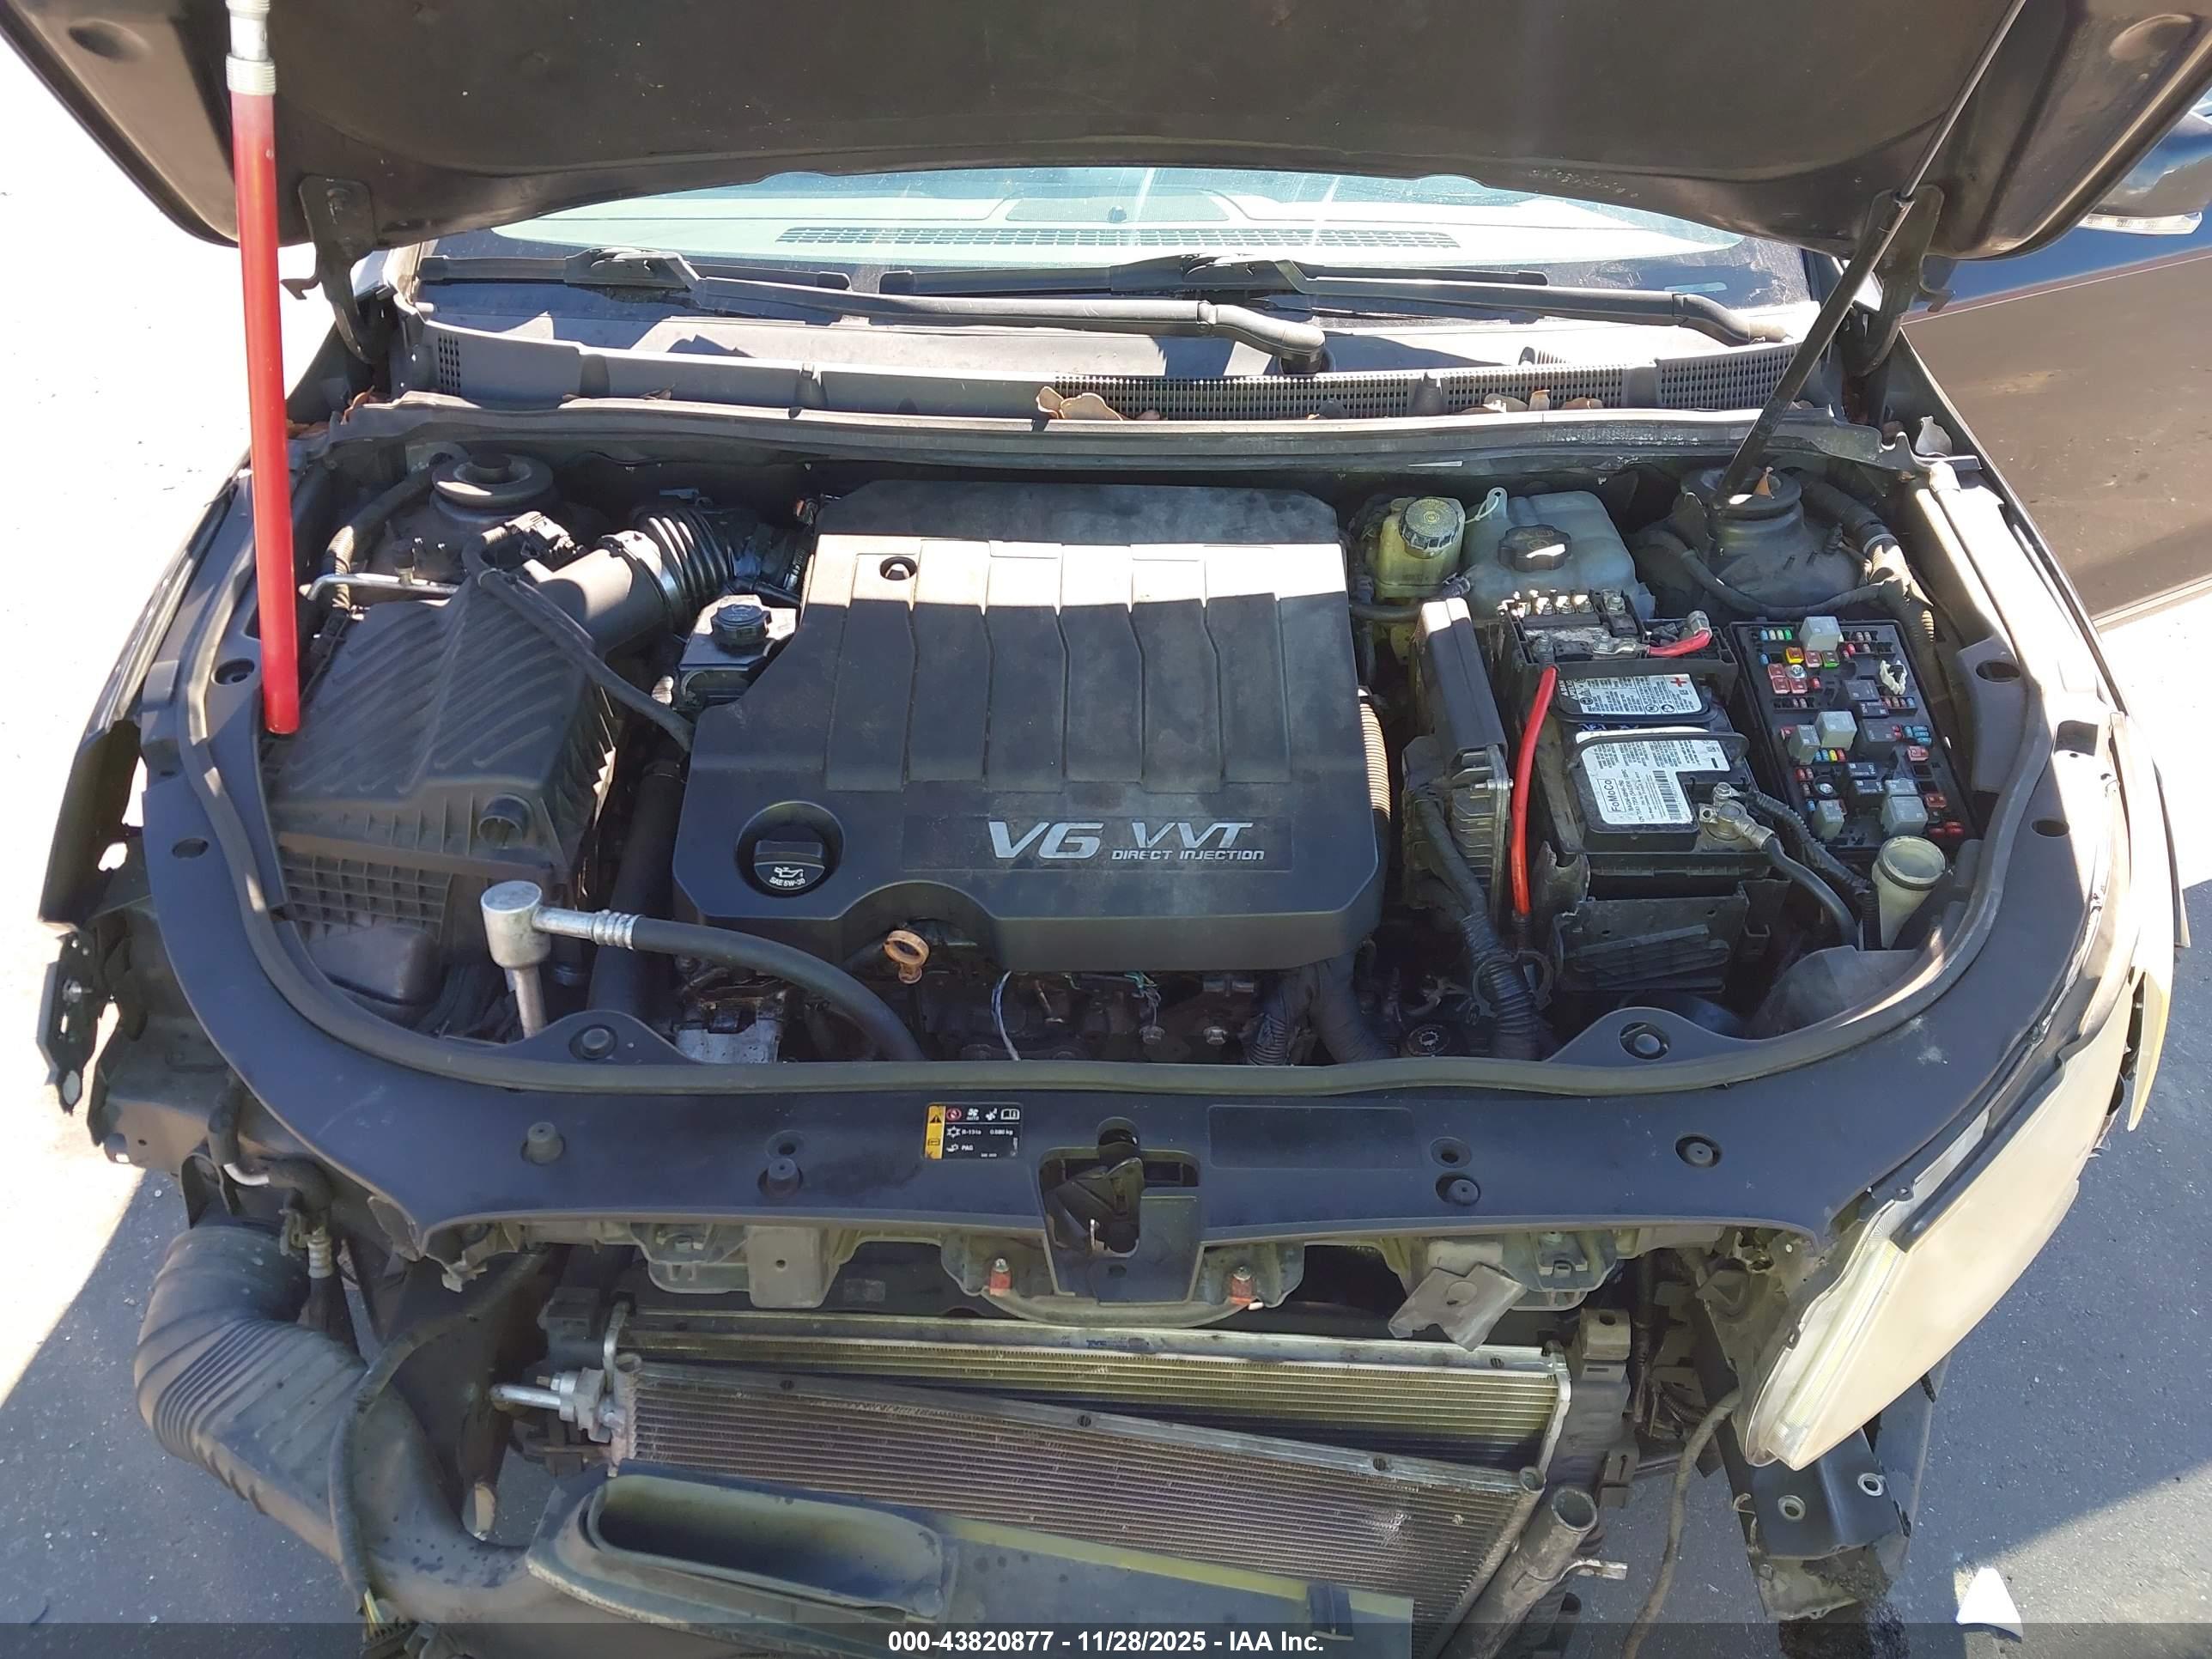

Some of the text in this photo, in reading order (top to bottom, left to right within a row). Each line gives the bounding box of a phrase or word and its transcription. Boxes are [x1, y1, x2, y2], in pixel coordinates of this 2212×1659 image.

[1604, 780, 1621, 812] FoMoCo
[988, 820, 1254, 860] V6 VVT
[1111, 849, 1266, 861] DIRECT INJECTION
[769, 877, 783, 886] SAE
